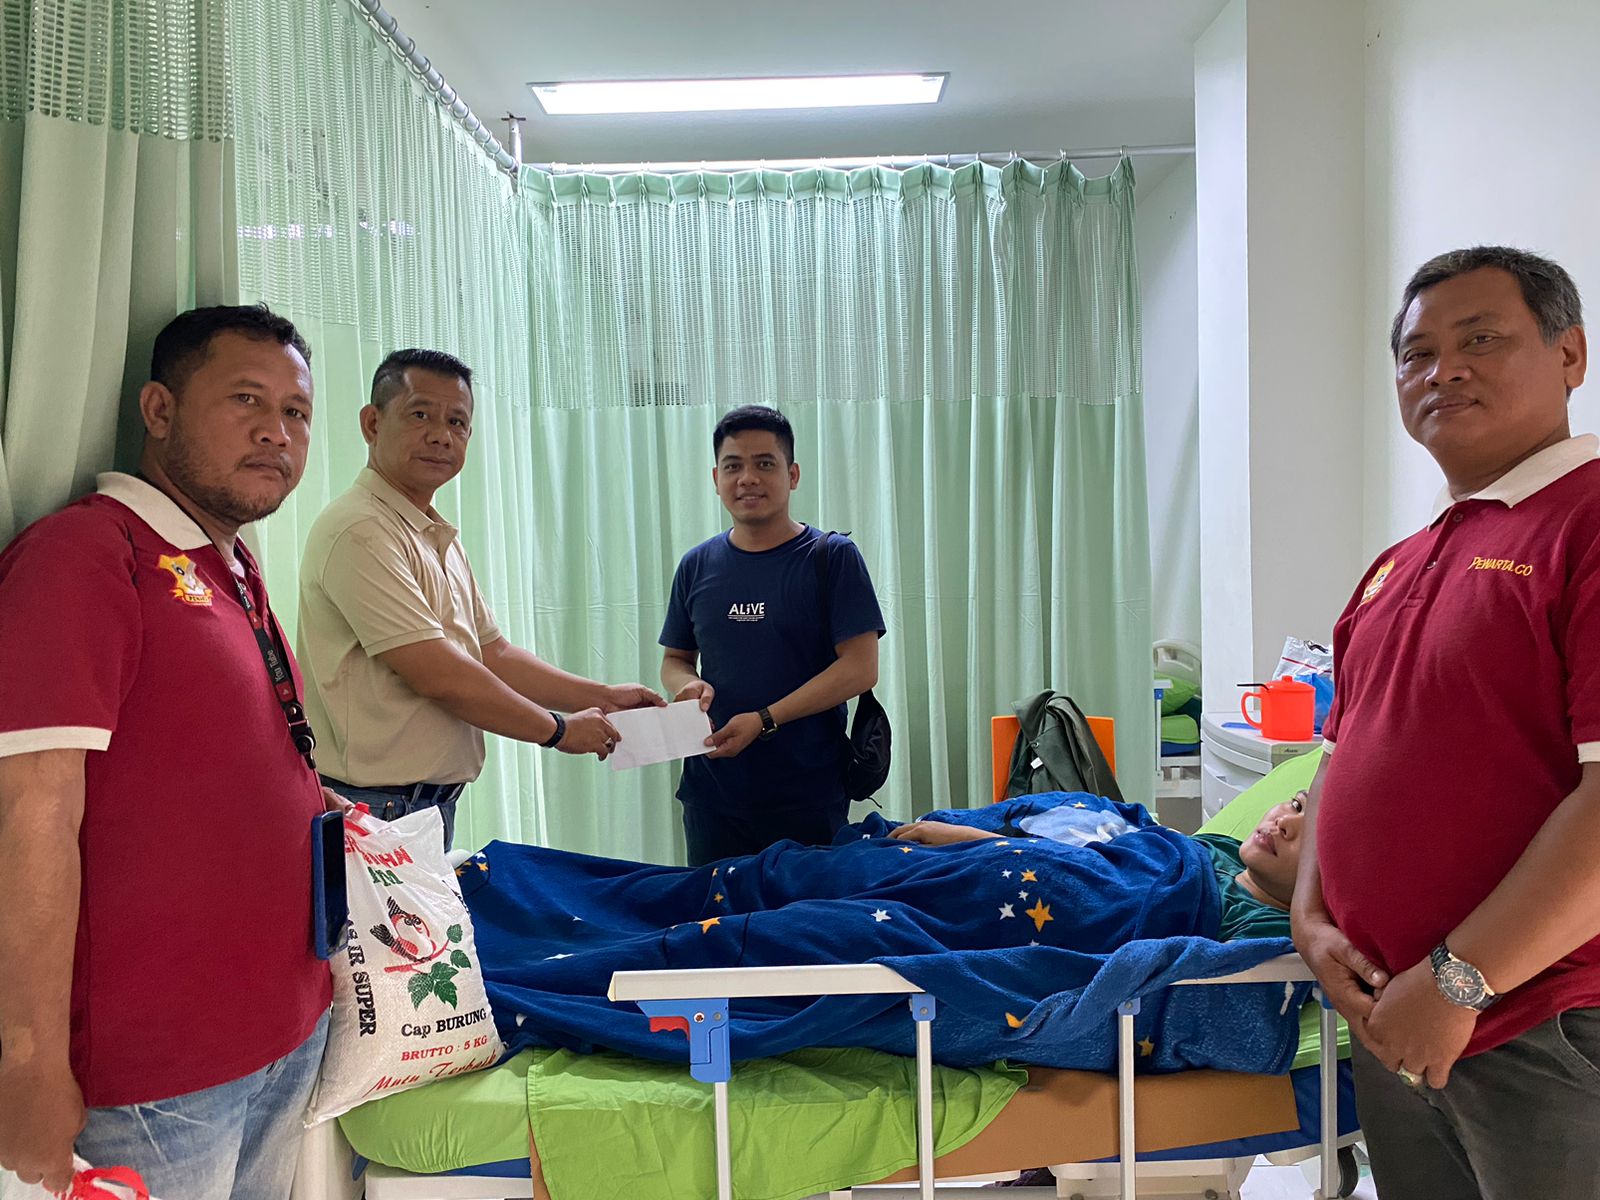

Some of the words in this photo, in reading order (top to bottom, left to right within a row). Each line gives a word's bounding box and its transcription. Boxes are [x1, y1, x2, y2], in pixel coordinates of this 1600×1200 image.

[1467, 556, 1534, 577] PEWARTA.CO
[352, 971, 377, 1037] SUPER
[401, 1023, 431, 1039] Cap
[436, 1008, 487, 1033] BURUNG
[401, 1045, 454, 1061] BRUTTO
[463, 1040, 471, 1050] 5
[473, 1035, 488, 1048] KG
